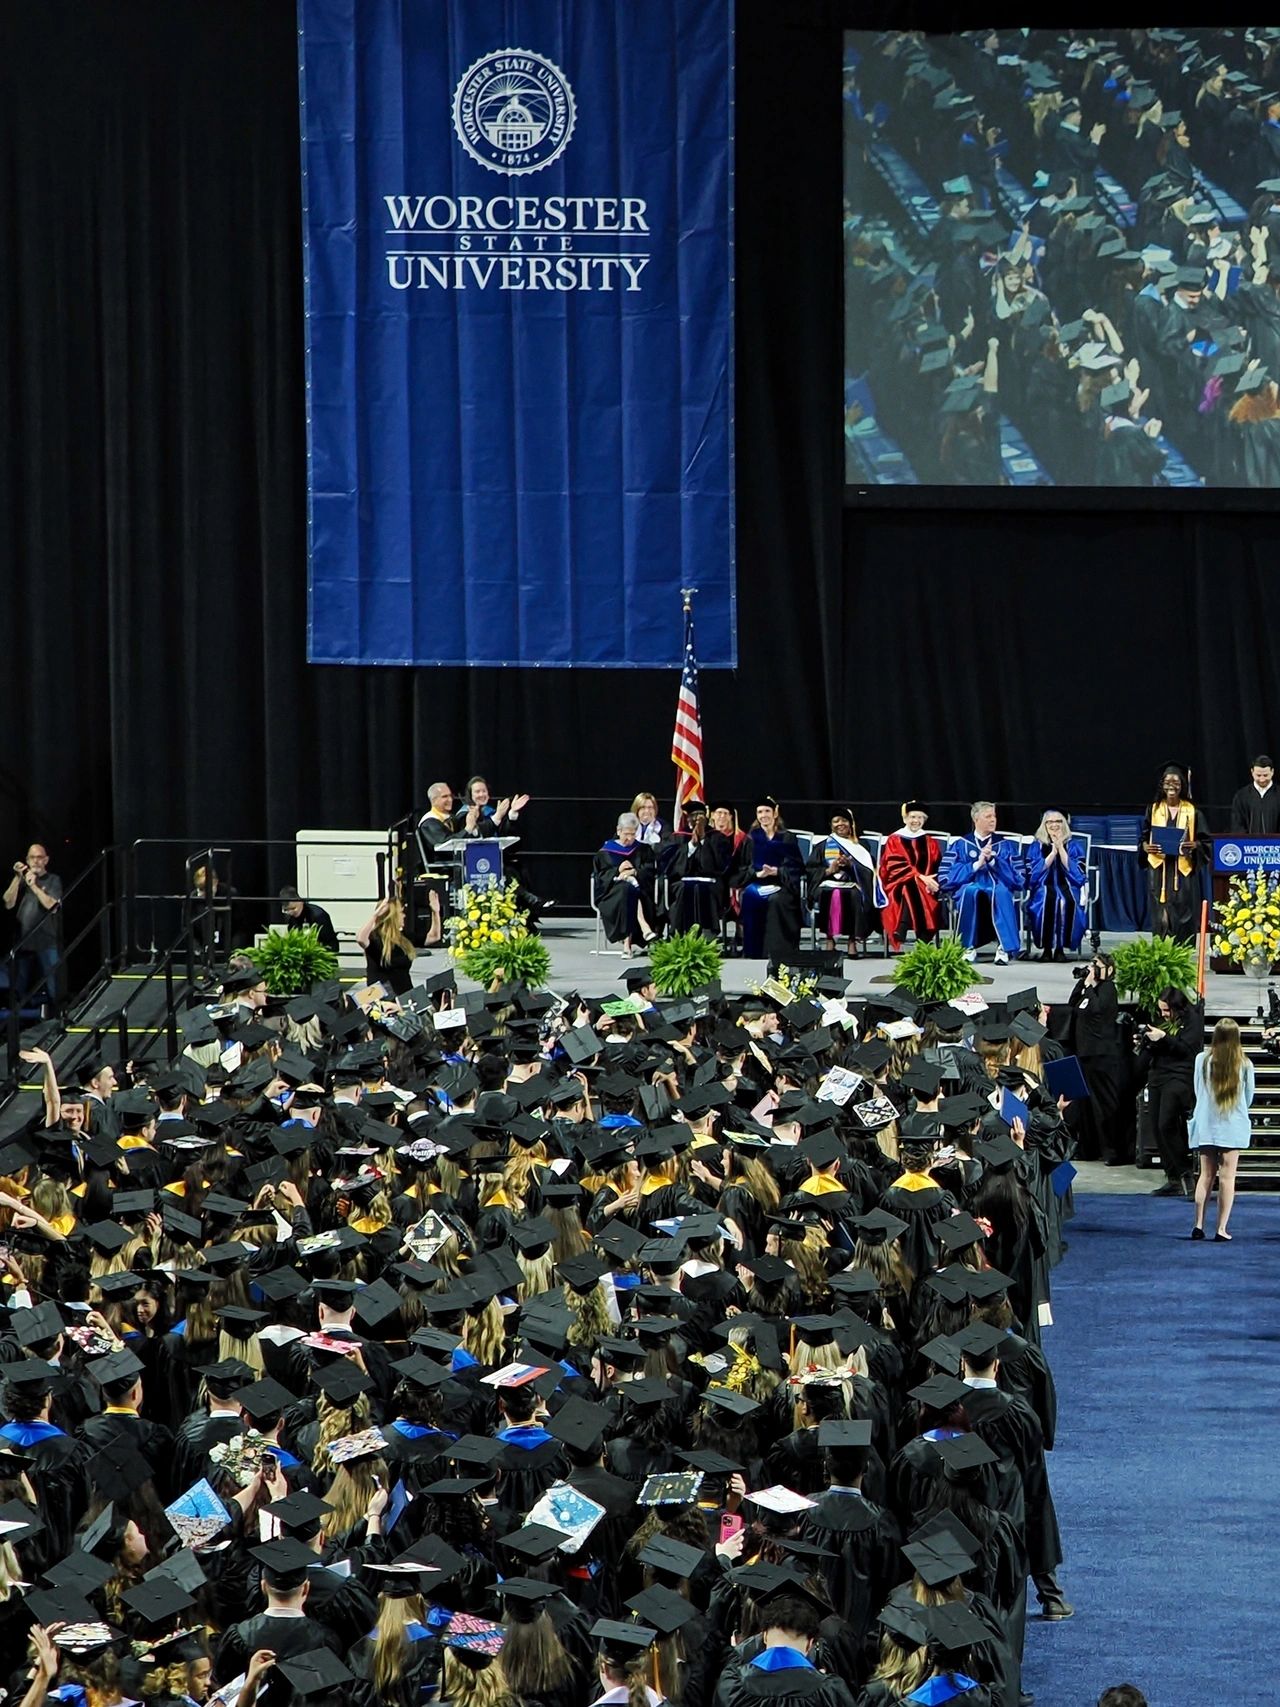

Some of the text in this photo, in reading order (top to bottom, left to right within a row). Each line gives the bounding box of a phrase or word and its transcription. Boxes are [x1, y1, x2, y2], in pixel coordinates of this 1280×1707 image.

[461, 57, 568, 146] WORCESTER STATE UNIVERSITY
[501, 151, 531, 166] 1874
[384, 195, 649, 231] WORCESTER
[459, 235, 574, 251] STATE
[386, 256, 650, 292] UNIVERSITY
